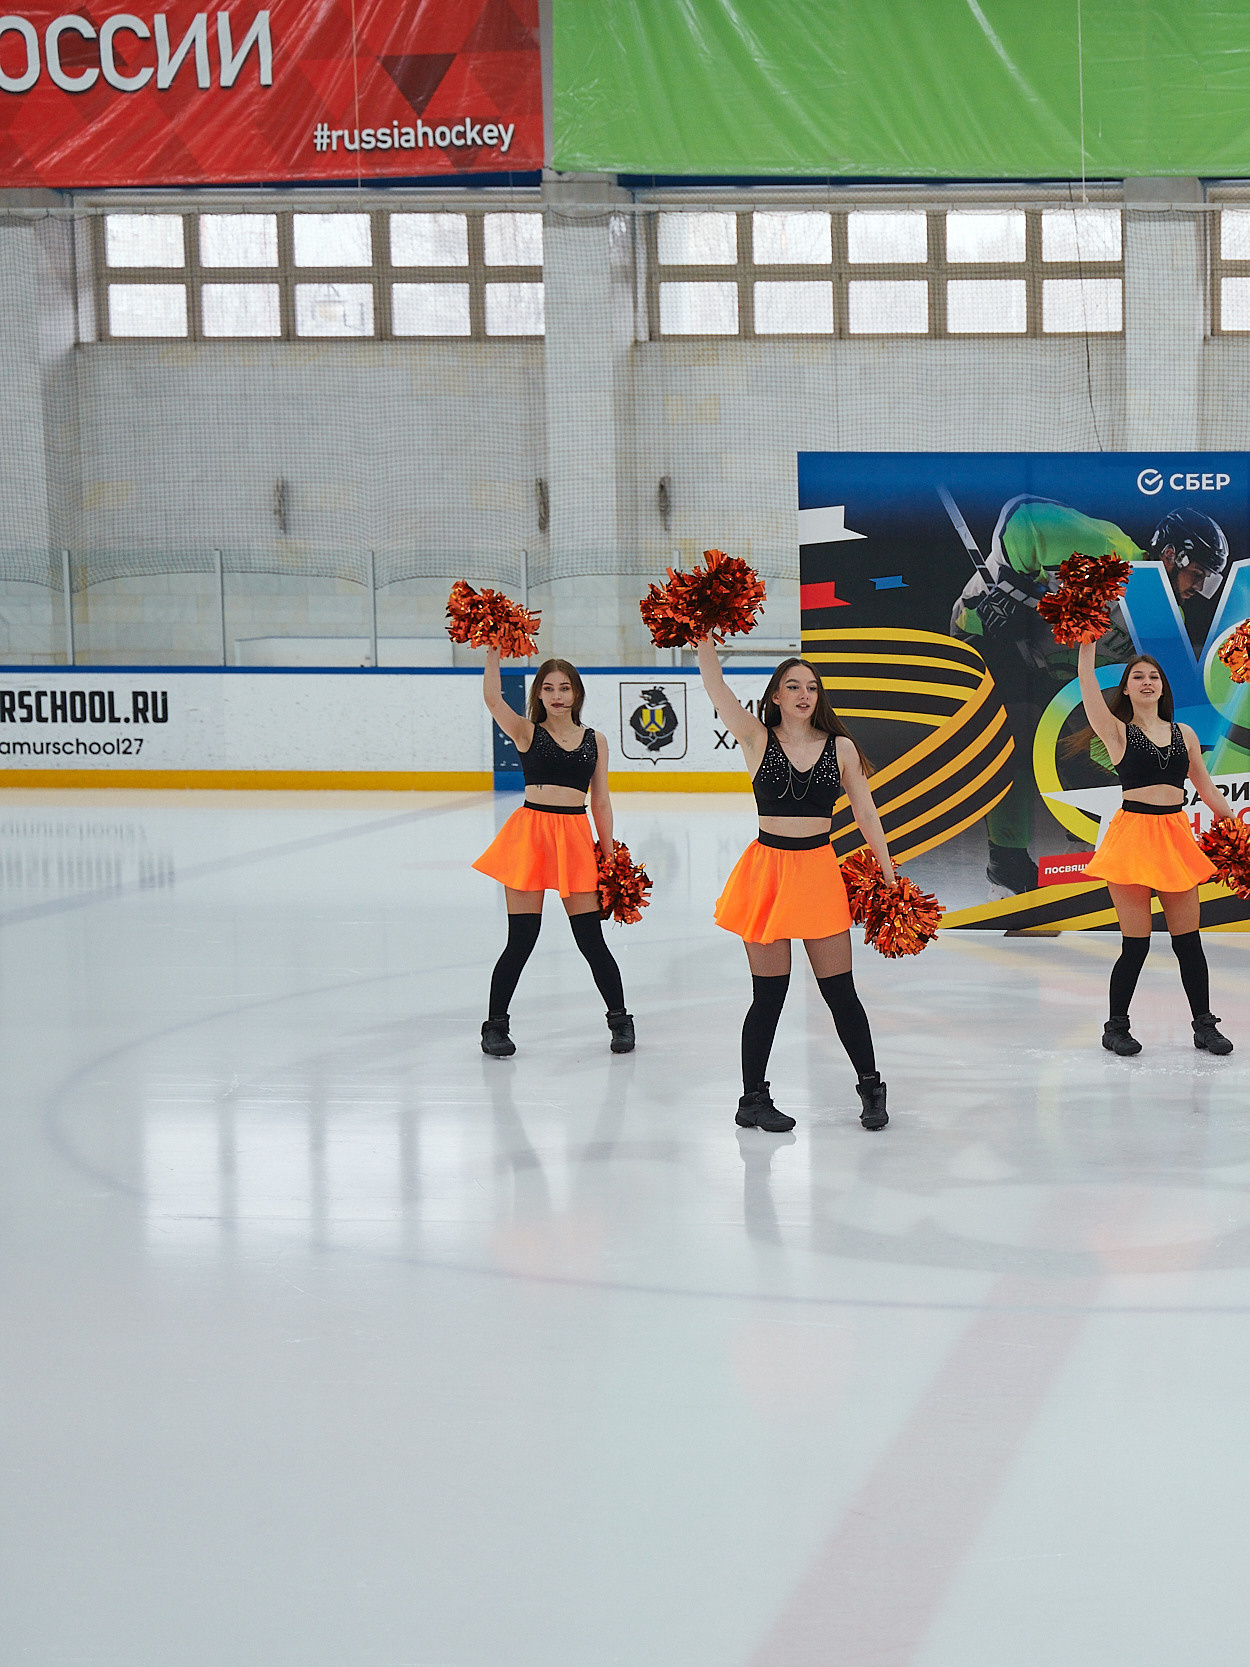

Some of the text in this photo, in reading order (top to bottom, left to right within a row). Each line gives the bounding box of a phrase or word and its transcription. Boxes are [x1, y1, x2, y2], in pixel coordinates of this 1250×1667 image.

[0, 10, 273, 93] ОССИИ
[313, 116, 515, 153] #russiahockey
[1169, 473, 1231, 491] СБЕР
[0, 690, 169, 723] RSCHOOL.RU
